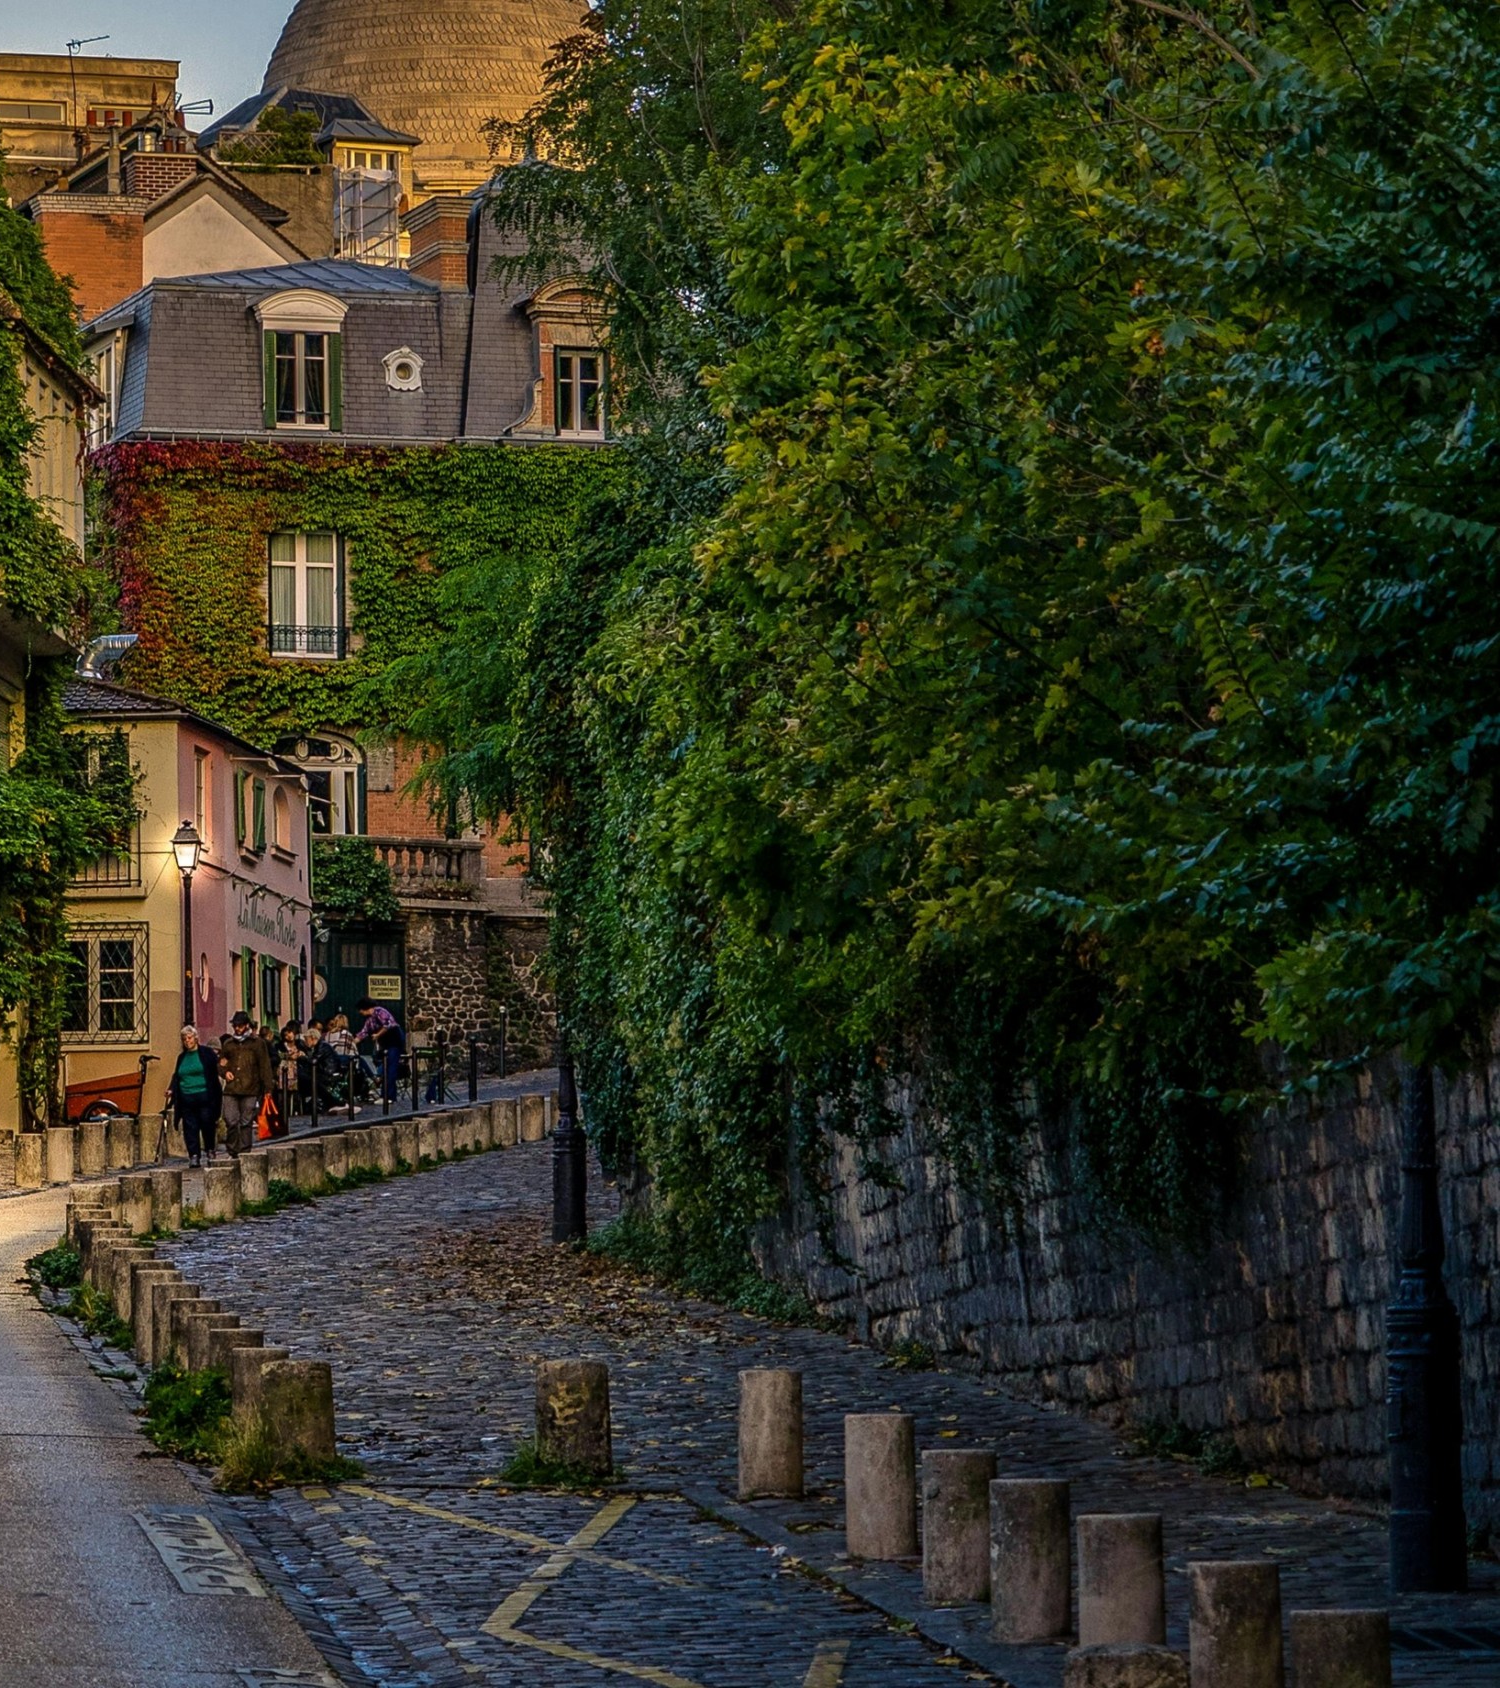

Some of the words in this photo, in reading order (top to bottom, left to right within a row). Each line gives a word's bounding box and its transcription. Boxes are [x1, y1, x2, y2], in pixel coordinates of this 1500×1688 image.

[238, 885, 249, 929] La
[250, 896, 275, 940] Maison
[276, 908, 297, 949] Rose
